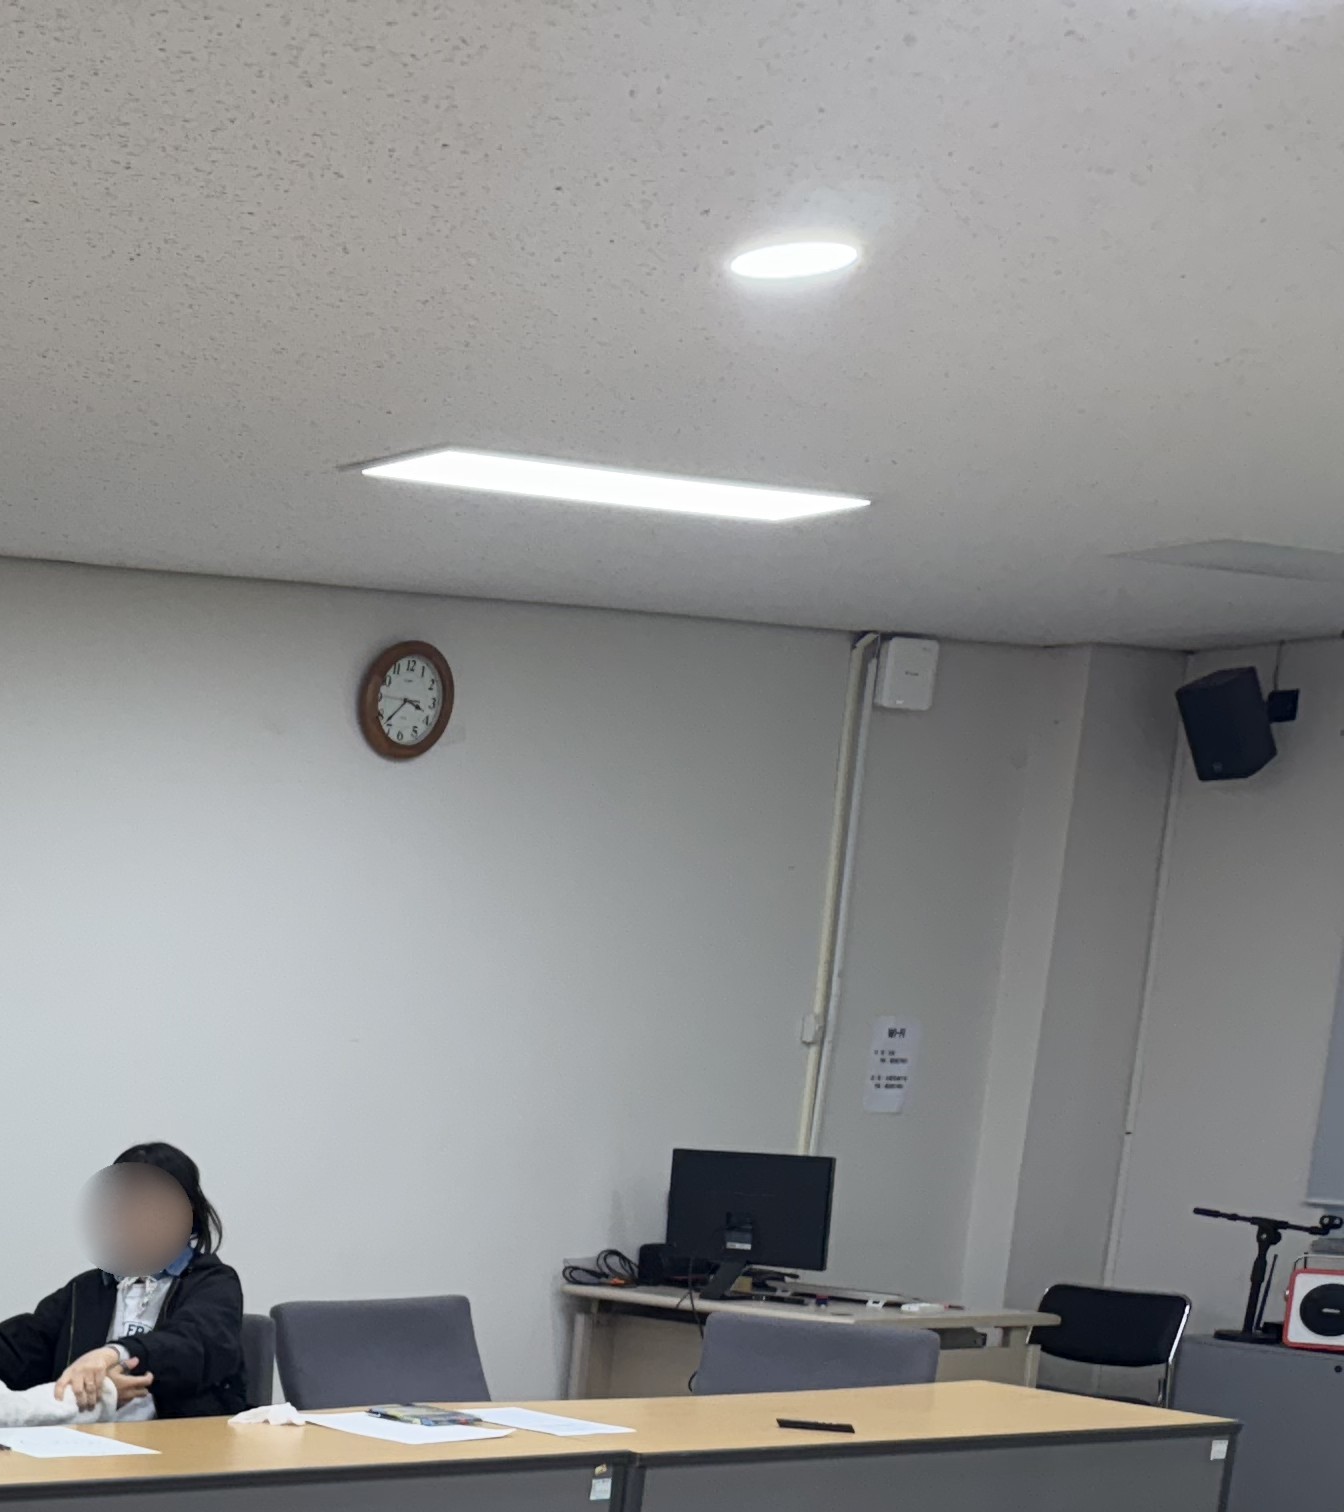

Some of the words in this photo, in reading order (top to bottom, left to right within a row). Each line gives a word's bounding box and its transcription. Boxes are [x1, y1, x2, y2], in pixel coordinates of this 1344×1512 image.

[393, 662, 400, 675] 11
[406, 660, 416, 672] 12
[421, 665, 425, 678] 1
[384, 675, 392, 687] 0
[428, 679, 435, 690] 2
[428, 698, 436, 709] 3
[423, 715, 430, 726] 4
[386, 723, 392, 736] 7
[397, 730, 403, 741] 6
[411, 725, 418, 737] 5
